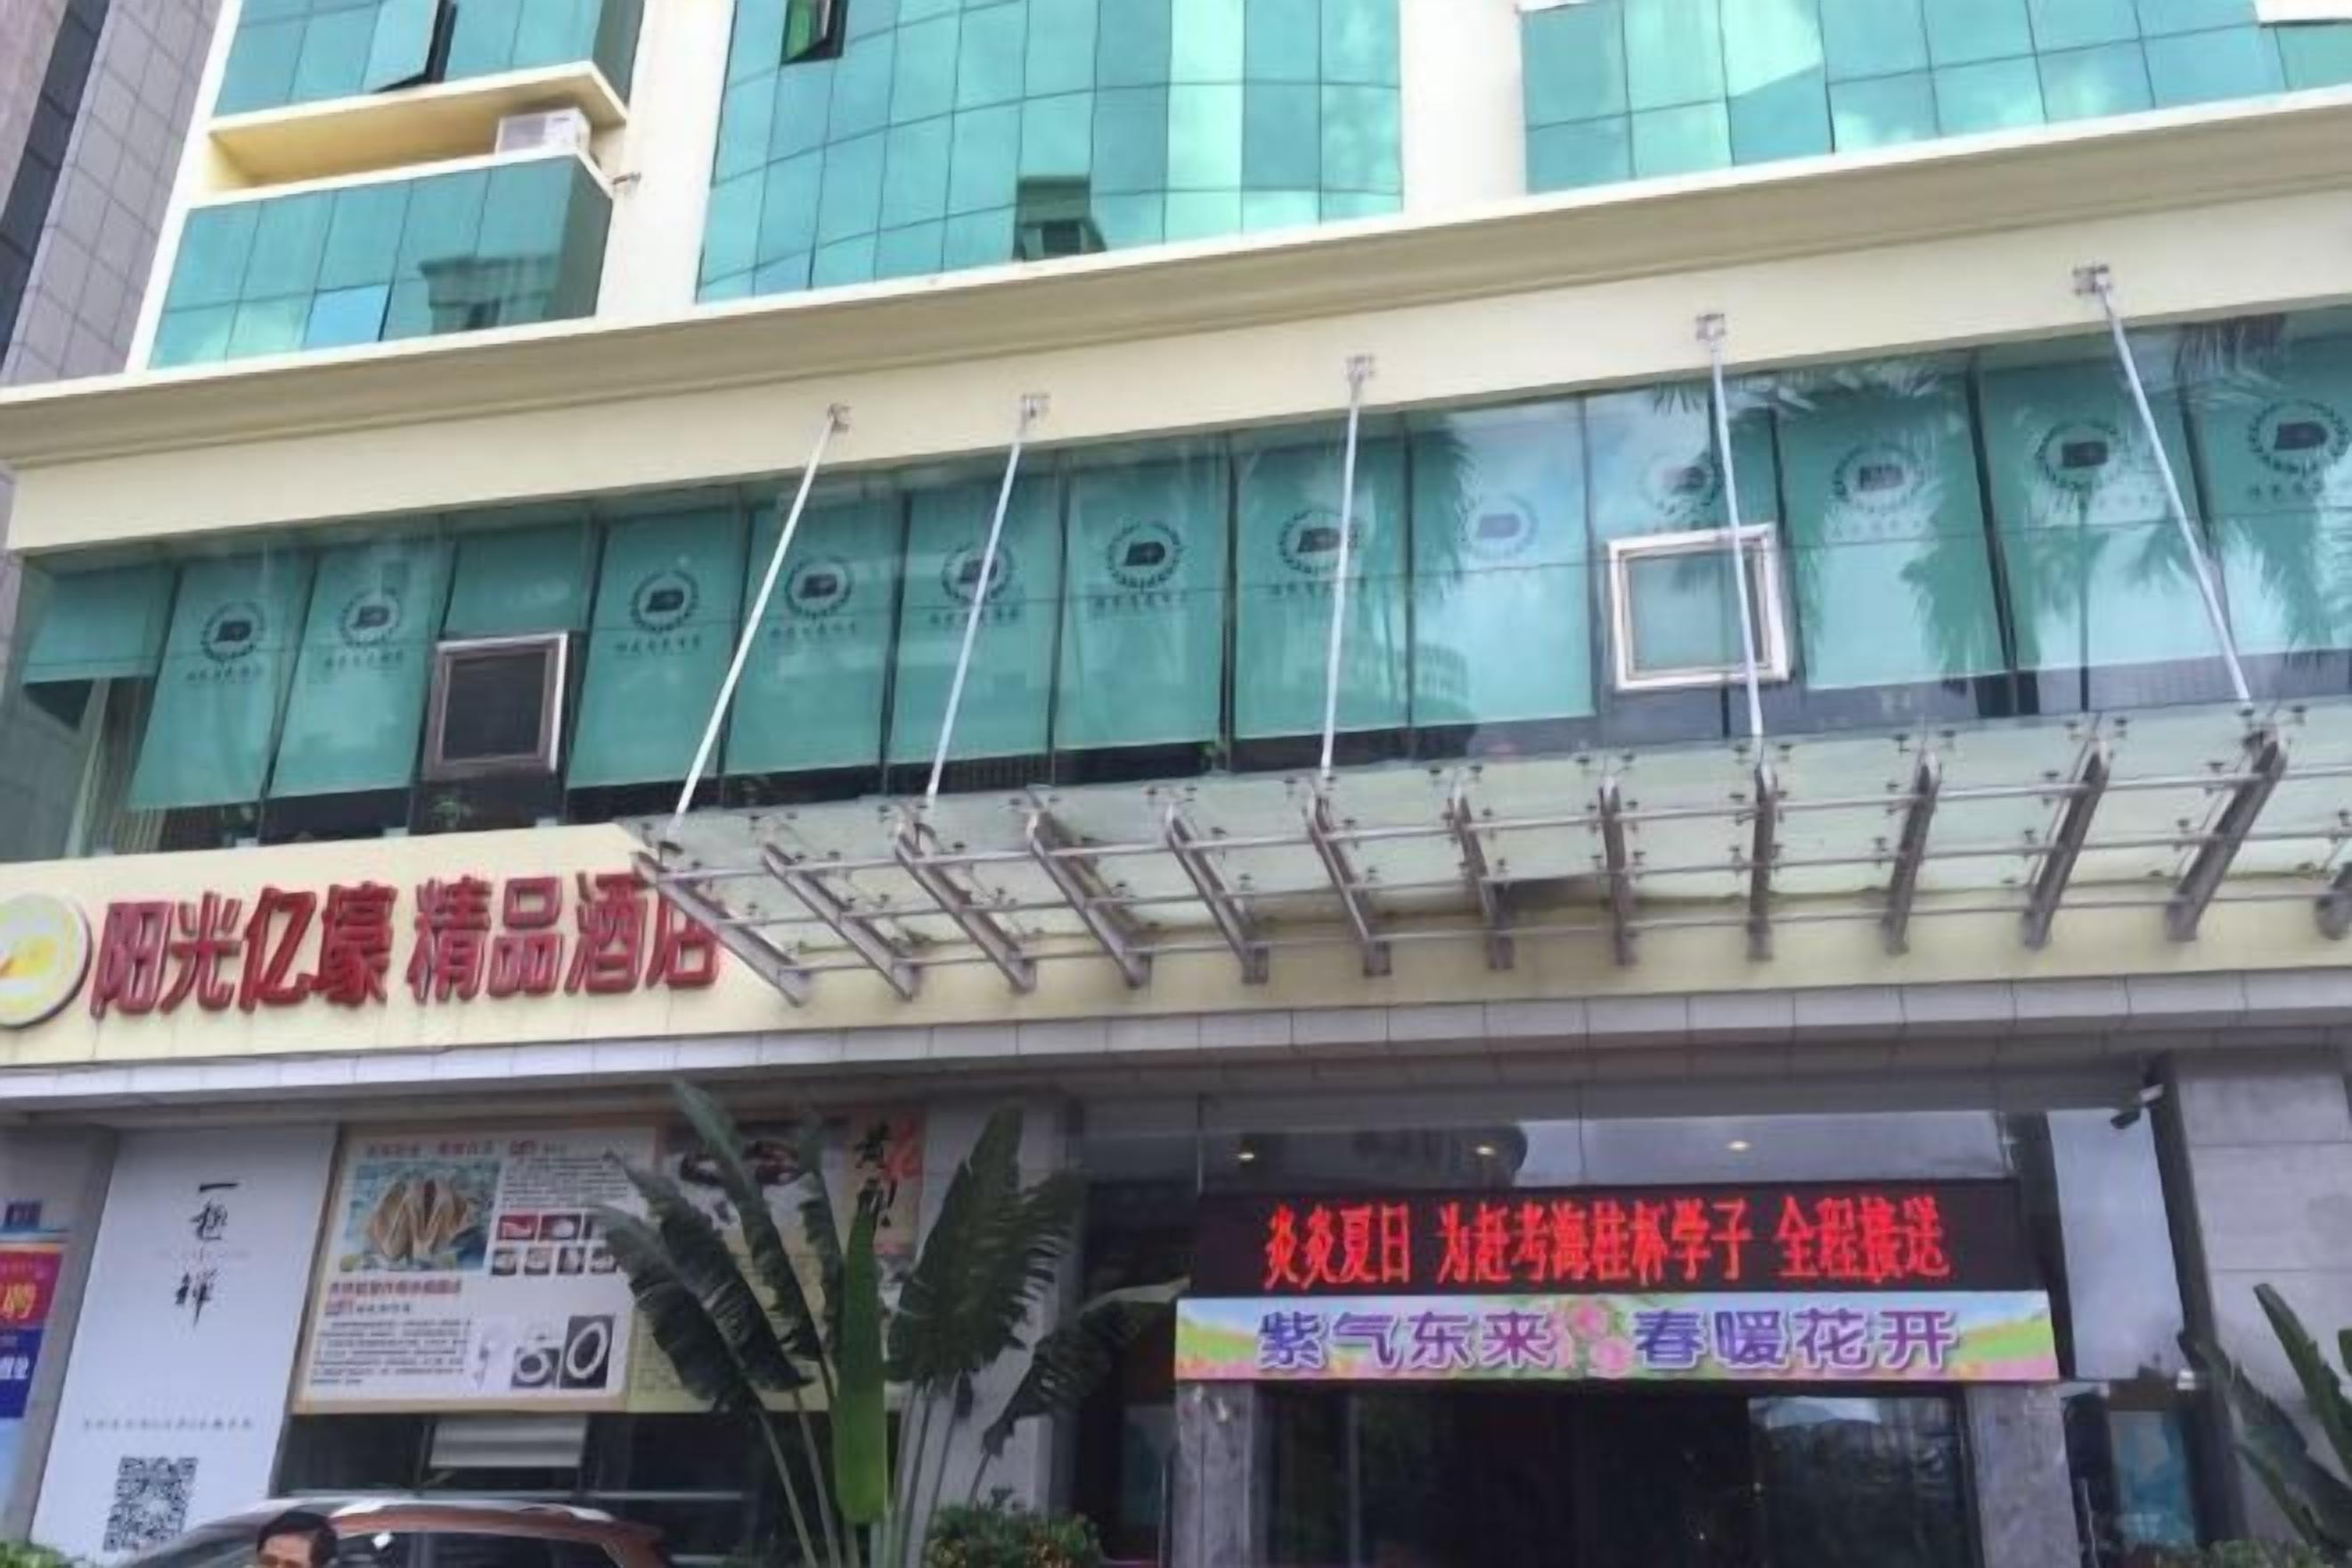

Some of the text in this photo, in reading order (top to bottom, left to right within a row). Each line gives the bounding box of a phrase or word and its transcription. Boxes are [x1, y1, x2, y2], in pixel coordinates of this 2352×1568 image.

[1264, 1203, 1411, 1290] 炎炎夏日
[1773, 1195, 1950, 1283] 全程接送
[1257, 1307, 1955, 1370] 紫气东来 春暖花开
